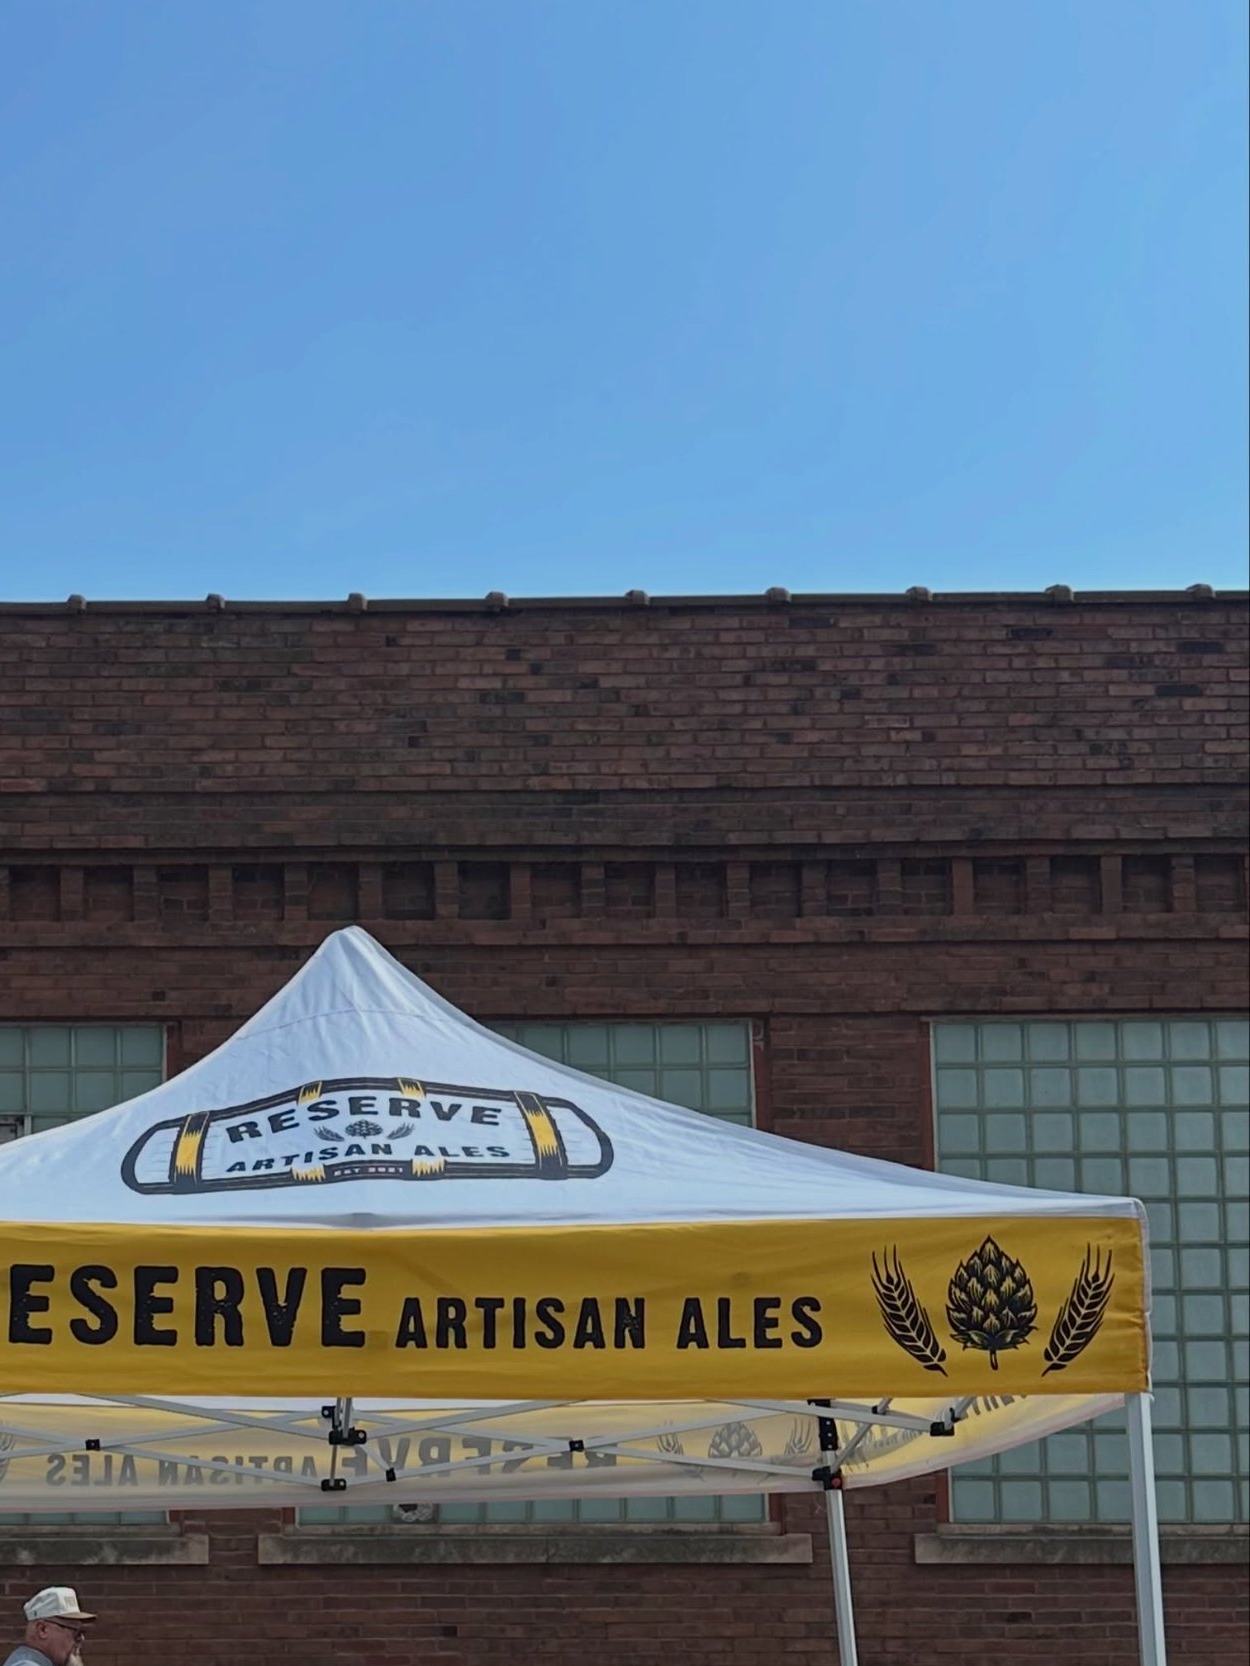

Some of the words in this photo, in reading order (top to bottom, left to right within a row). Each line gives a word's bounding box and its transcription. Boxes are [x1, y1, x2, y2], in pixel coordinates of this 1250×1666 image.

[226, 1096, 502, 1143] RESERVE
[226, 1144, 392, 1172] ARTISAN
[414, 1145, 510, 1158] ALES
[395, 1296, 645, 1350] ARTISAN
[677, 1296, 824, 1350] ALES
